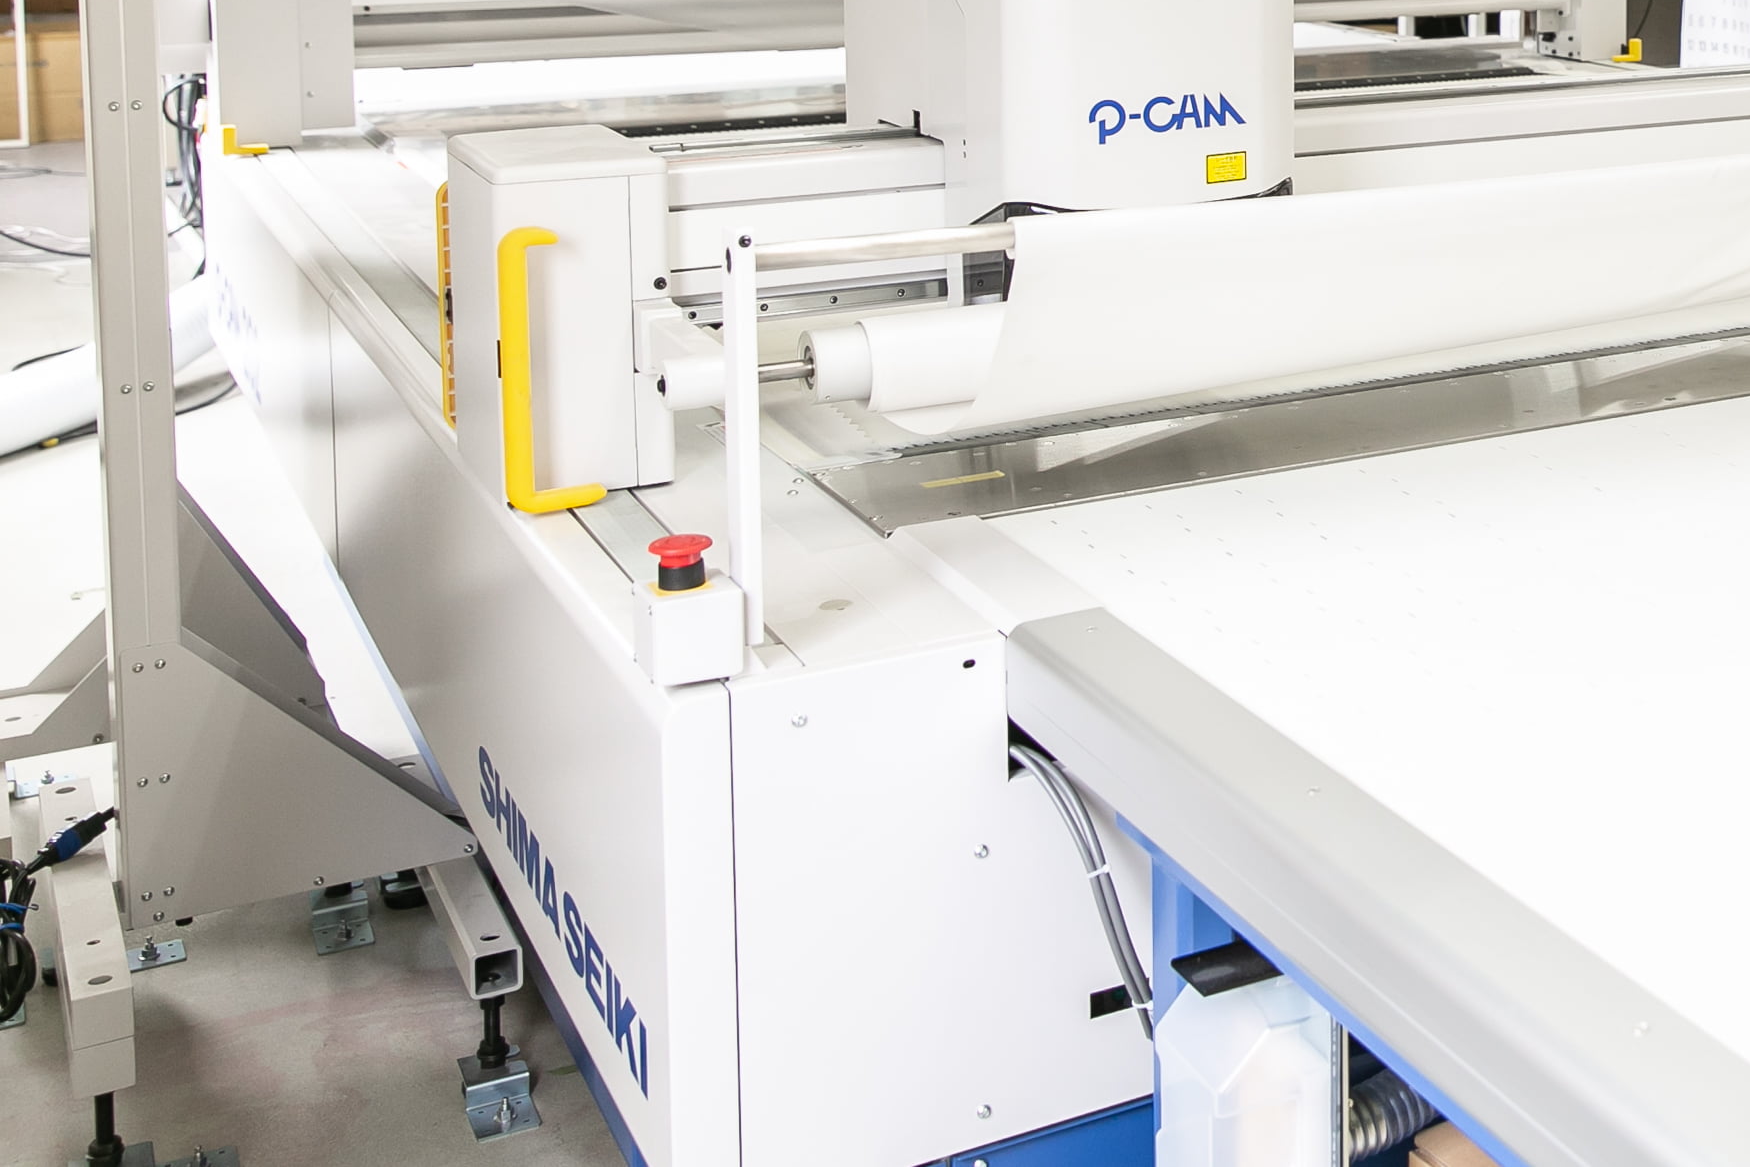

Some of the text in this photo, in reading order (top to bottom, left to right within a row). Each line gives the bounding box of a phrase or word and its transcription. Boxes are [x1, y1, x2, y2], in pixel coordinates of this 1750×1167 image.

[1089, 92, 1247, 145] P-CAM
[478, 745, 649, 1101] SHIMA SEIKI
